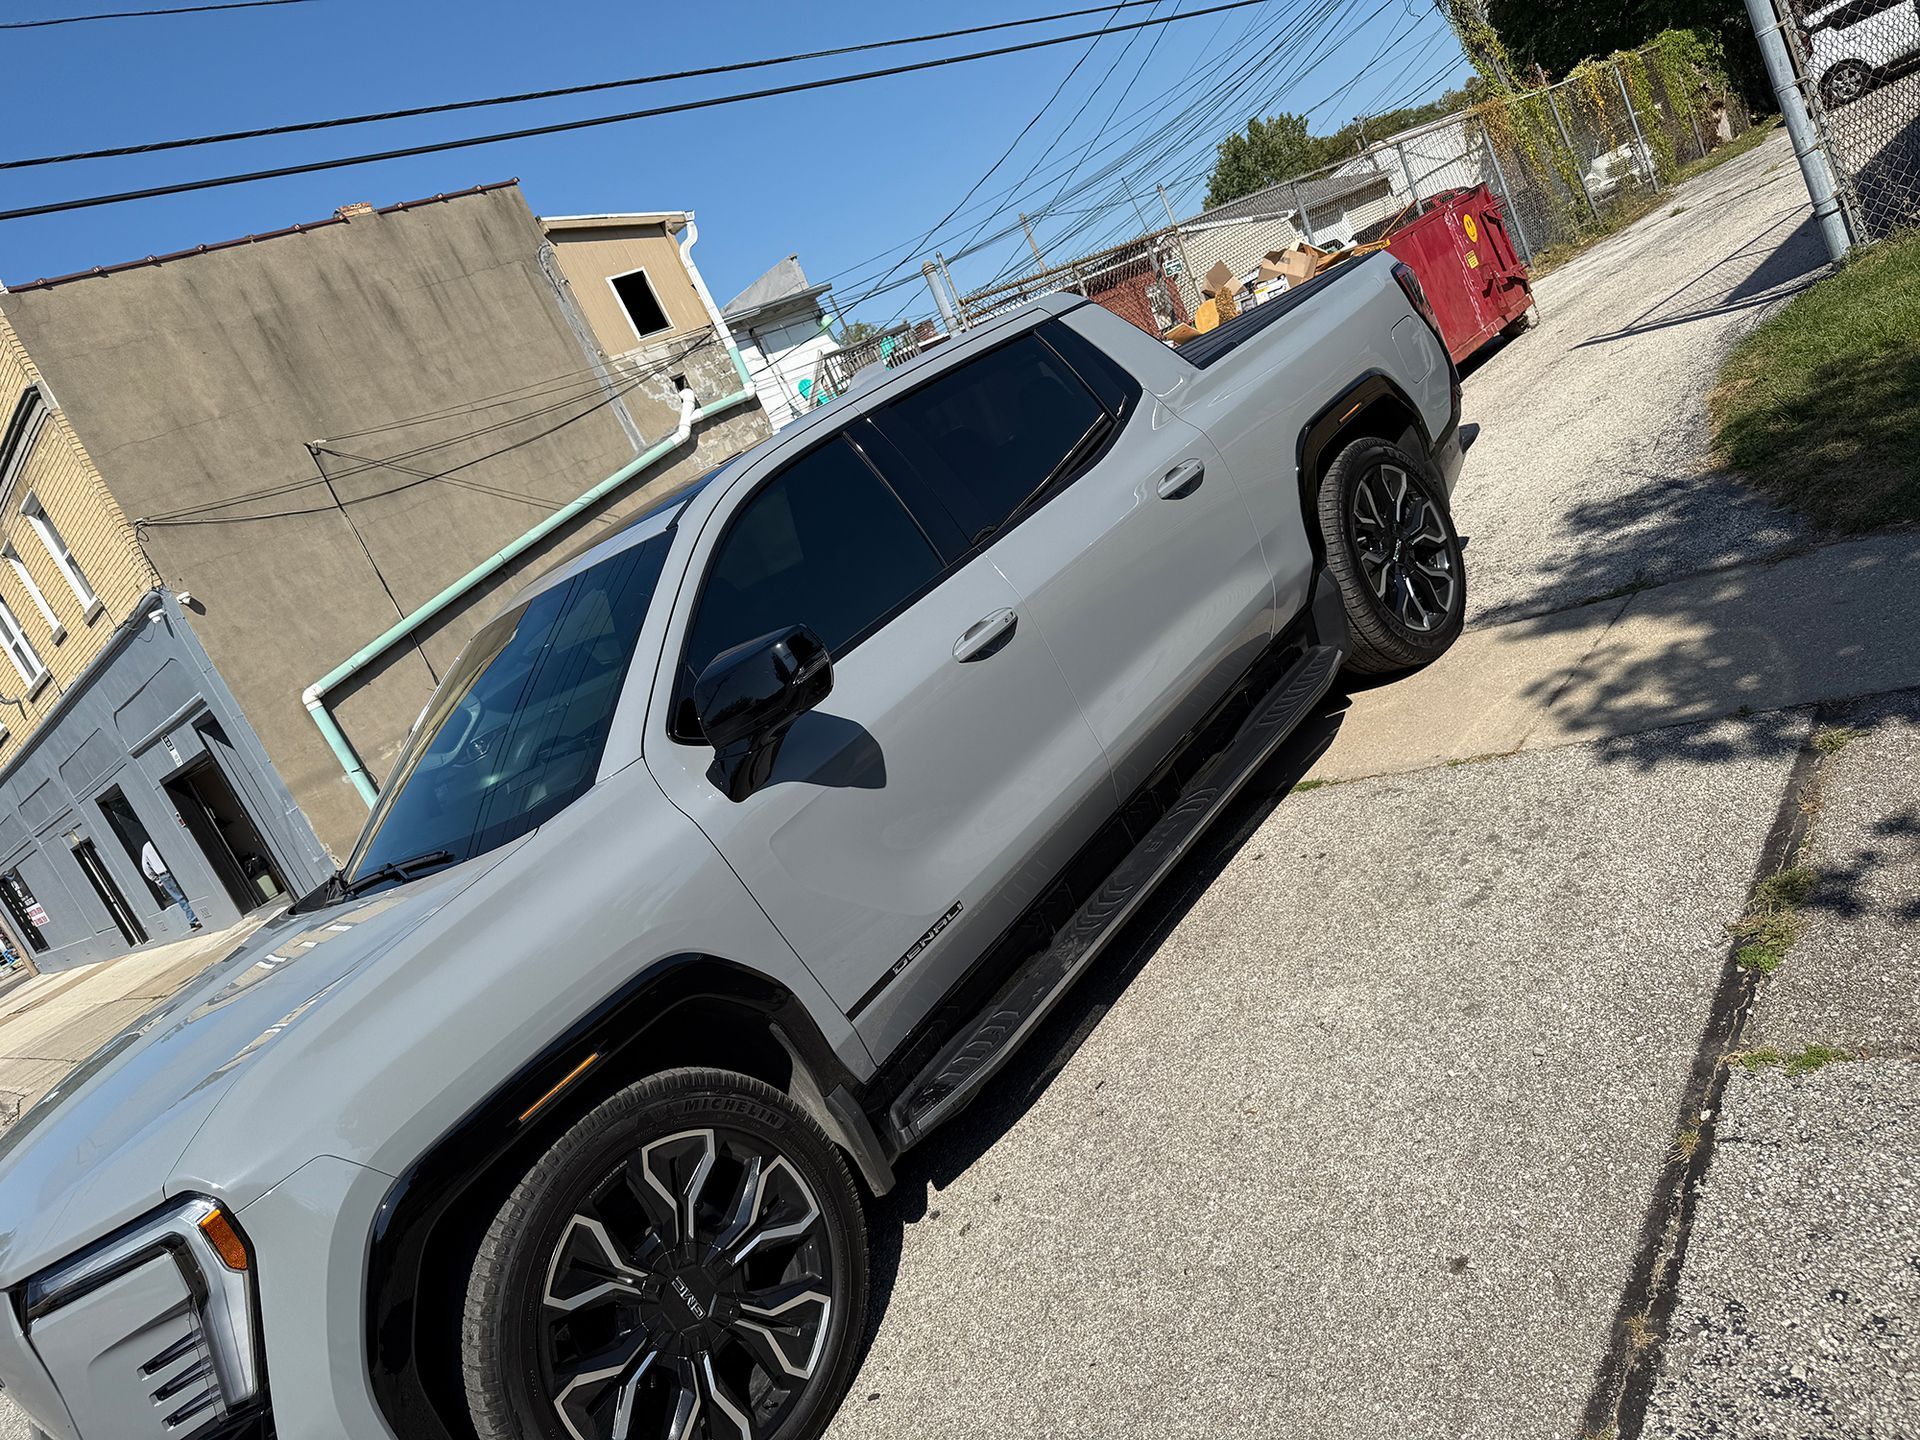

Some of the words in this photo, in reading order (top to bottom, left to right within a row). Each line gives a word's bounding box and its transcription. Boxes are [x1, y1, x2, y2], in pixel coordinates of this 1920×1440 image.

[892, 903, 963, 975] DENALI
[683, 1098, 780, 1127] MICHELIN
[671, 1275, 706, 1320] GMC
